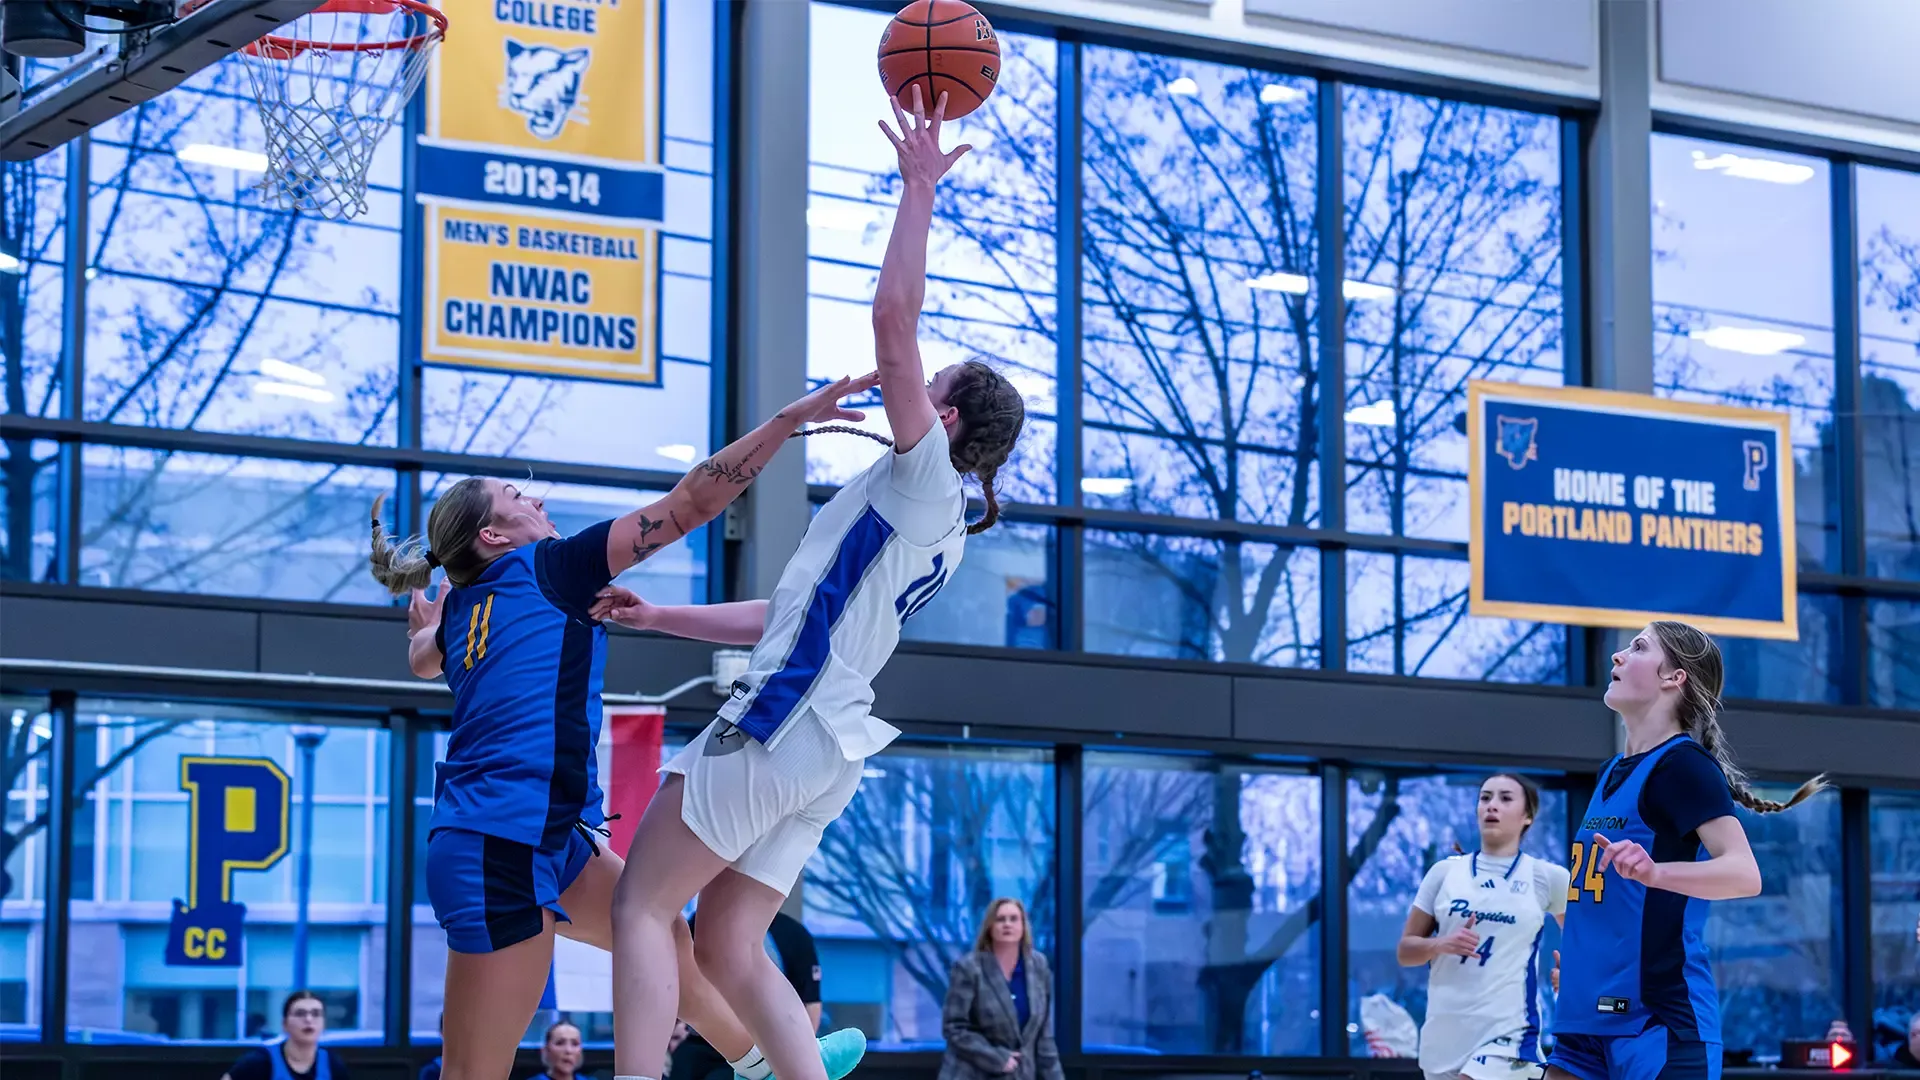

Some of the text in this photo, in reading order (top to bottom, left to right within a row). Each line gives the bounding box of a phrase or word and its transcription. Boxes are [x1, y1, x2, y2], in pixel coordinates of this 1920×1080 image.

[496, 0, 596, 33] COLLEGE
[483, 160, 601, 206] 2013-14
[445, 219, 638, 260] MEN'S BASKETBALL
[492, 263, 590, 304] NWAC
[445, 300, 638, 350] CHAMPIONS
[1743, 441, 1768, 491] P
[1554, 467, 1716, 514] HOME OF THE
[1503, 501, 1763, 556] PORTLAND PANTHERS
[463, 593, 495, 671] 11
[180, 754, 292, 905] P
[1567, 840, 1605, 904] 24
[184, 926, 228, 959] CC
[1459, 935, 1495, 967] 4
